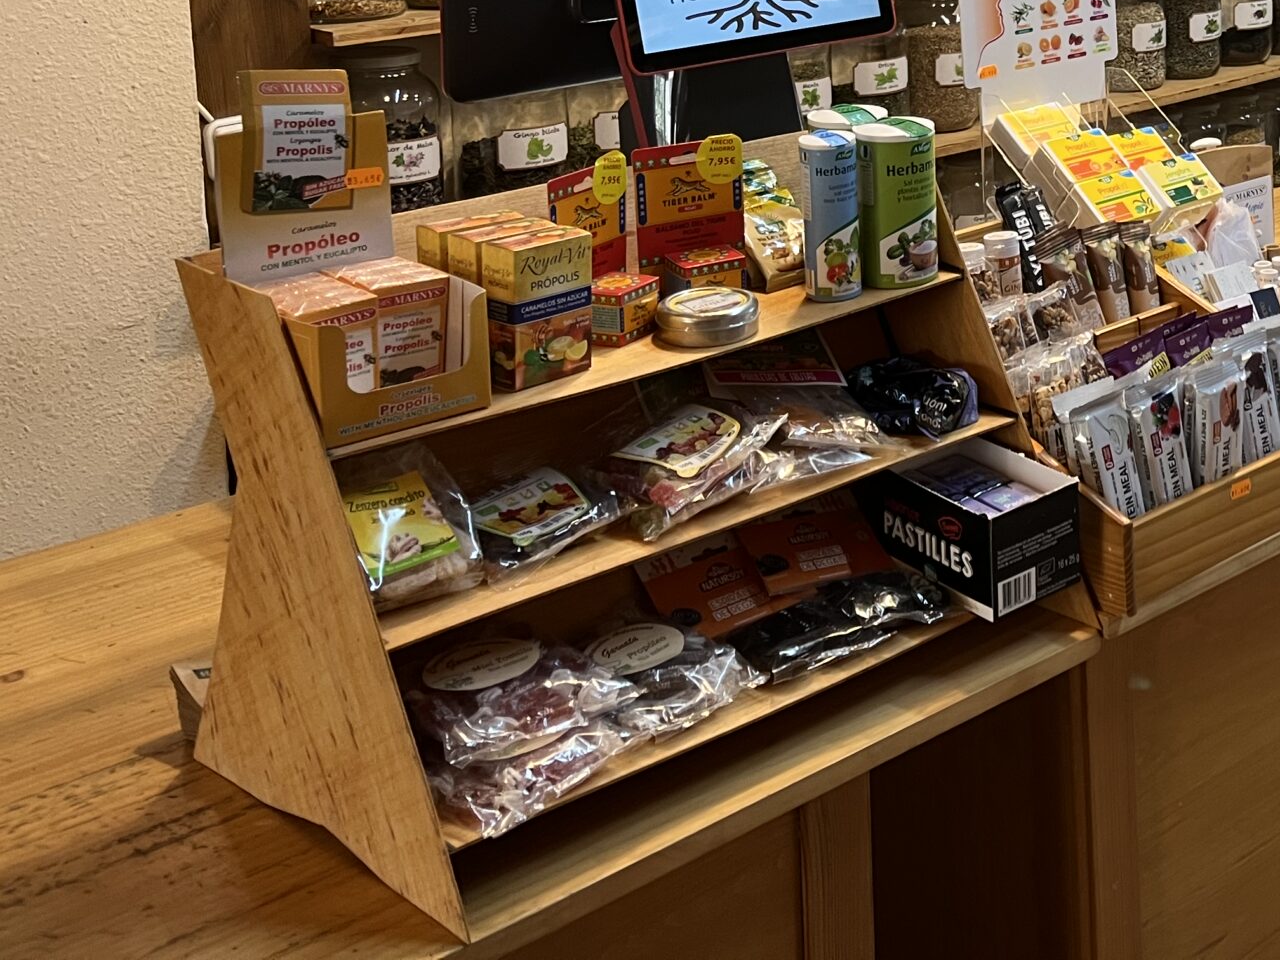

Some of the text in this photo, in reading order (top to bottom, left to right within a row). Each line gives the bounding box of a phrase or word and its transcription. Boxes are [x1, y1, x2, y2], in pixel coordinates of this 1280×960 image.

[282, 83, 341, 94] MARNYS
[273, 117, 336, 131] Propóleo
[275, 145, 334, 157] Propolis
[708, 144, 736, 152] AHORRO
[710, 138, 734, 146] PRECIO
[708, 156, 736, 166] 7,95€
[600, 176, 621, 185] 7,95€
[662, 192, 718, 208] TIGER BALM
[1012, 209, 1036, 252] TUBI
[267, 229, 361, 259] Propóleo
[260, 244, 369, 272] CON MENTOL Y EUCALIPTO
[393, 288, 442, 304] MARNYS
[521, 298, 557, 314] CARAMELOS
[557, 296, 567, 305] SIN
[567, 290, 589, 303] AZÚCAR
[383, 316, 433, 332] Propóleo
[384, 339, 430, 354] Propolis
[380, 392, 441, 416] Propolis
[1256, 403, 1269, 435] MEAL
[1221, 437, 1231, 469] MEAL
[1166, 446, 1179, 481] MEAL
[1118, 460, 1133, 495] MEAL
[346, 488, 427, 514] Zenzero candito
[883, 510, 975, 580] PASTILLES
